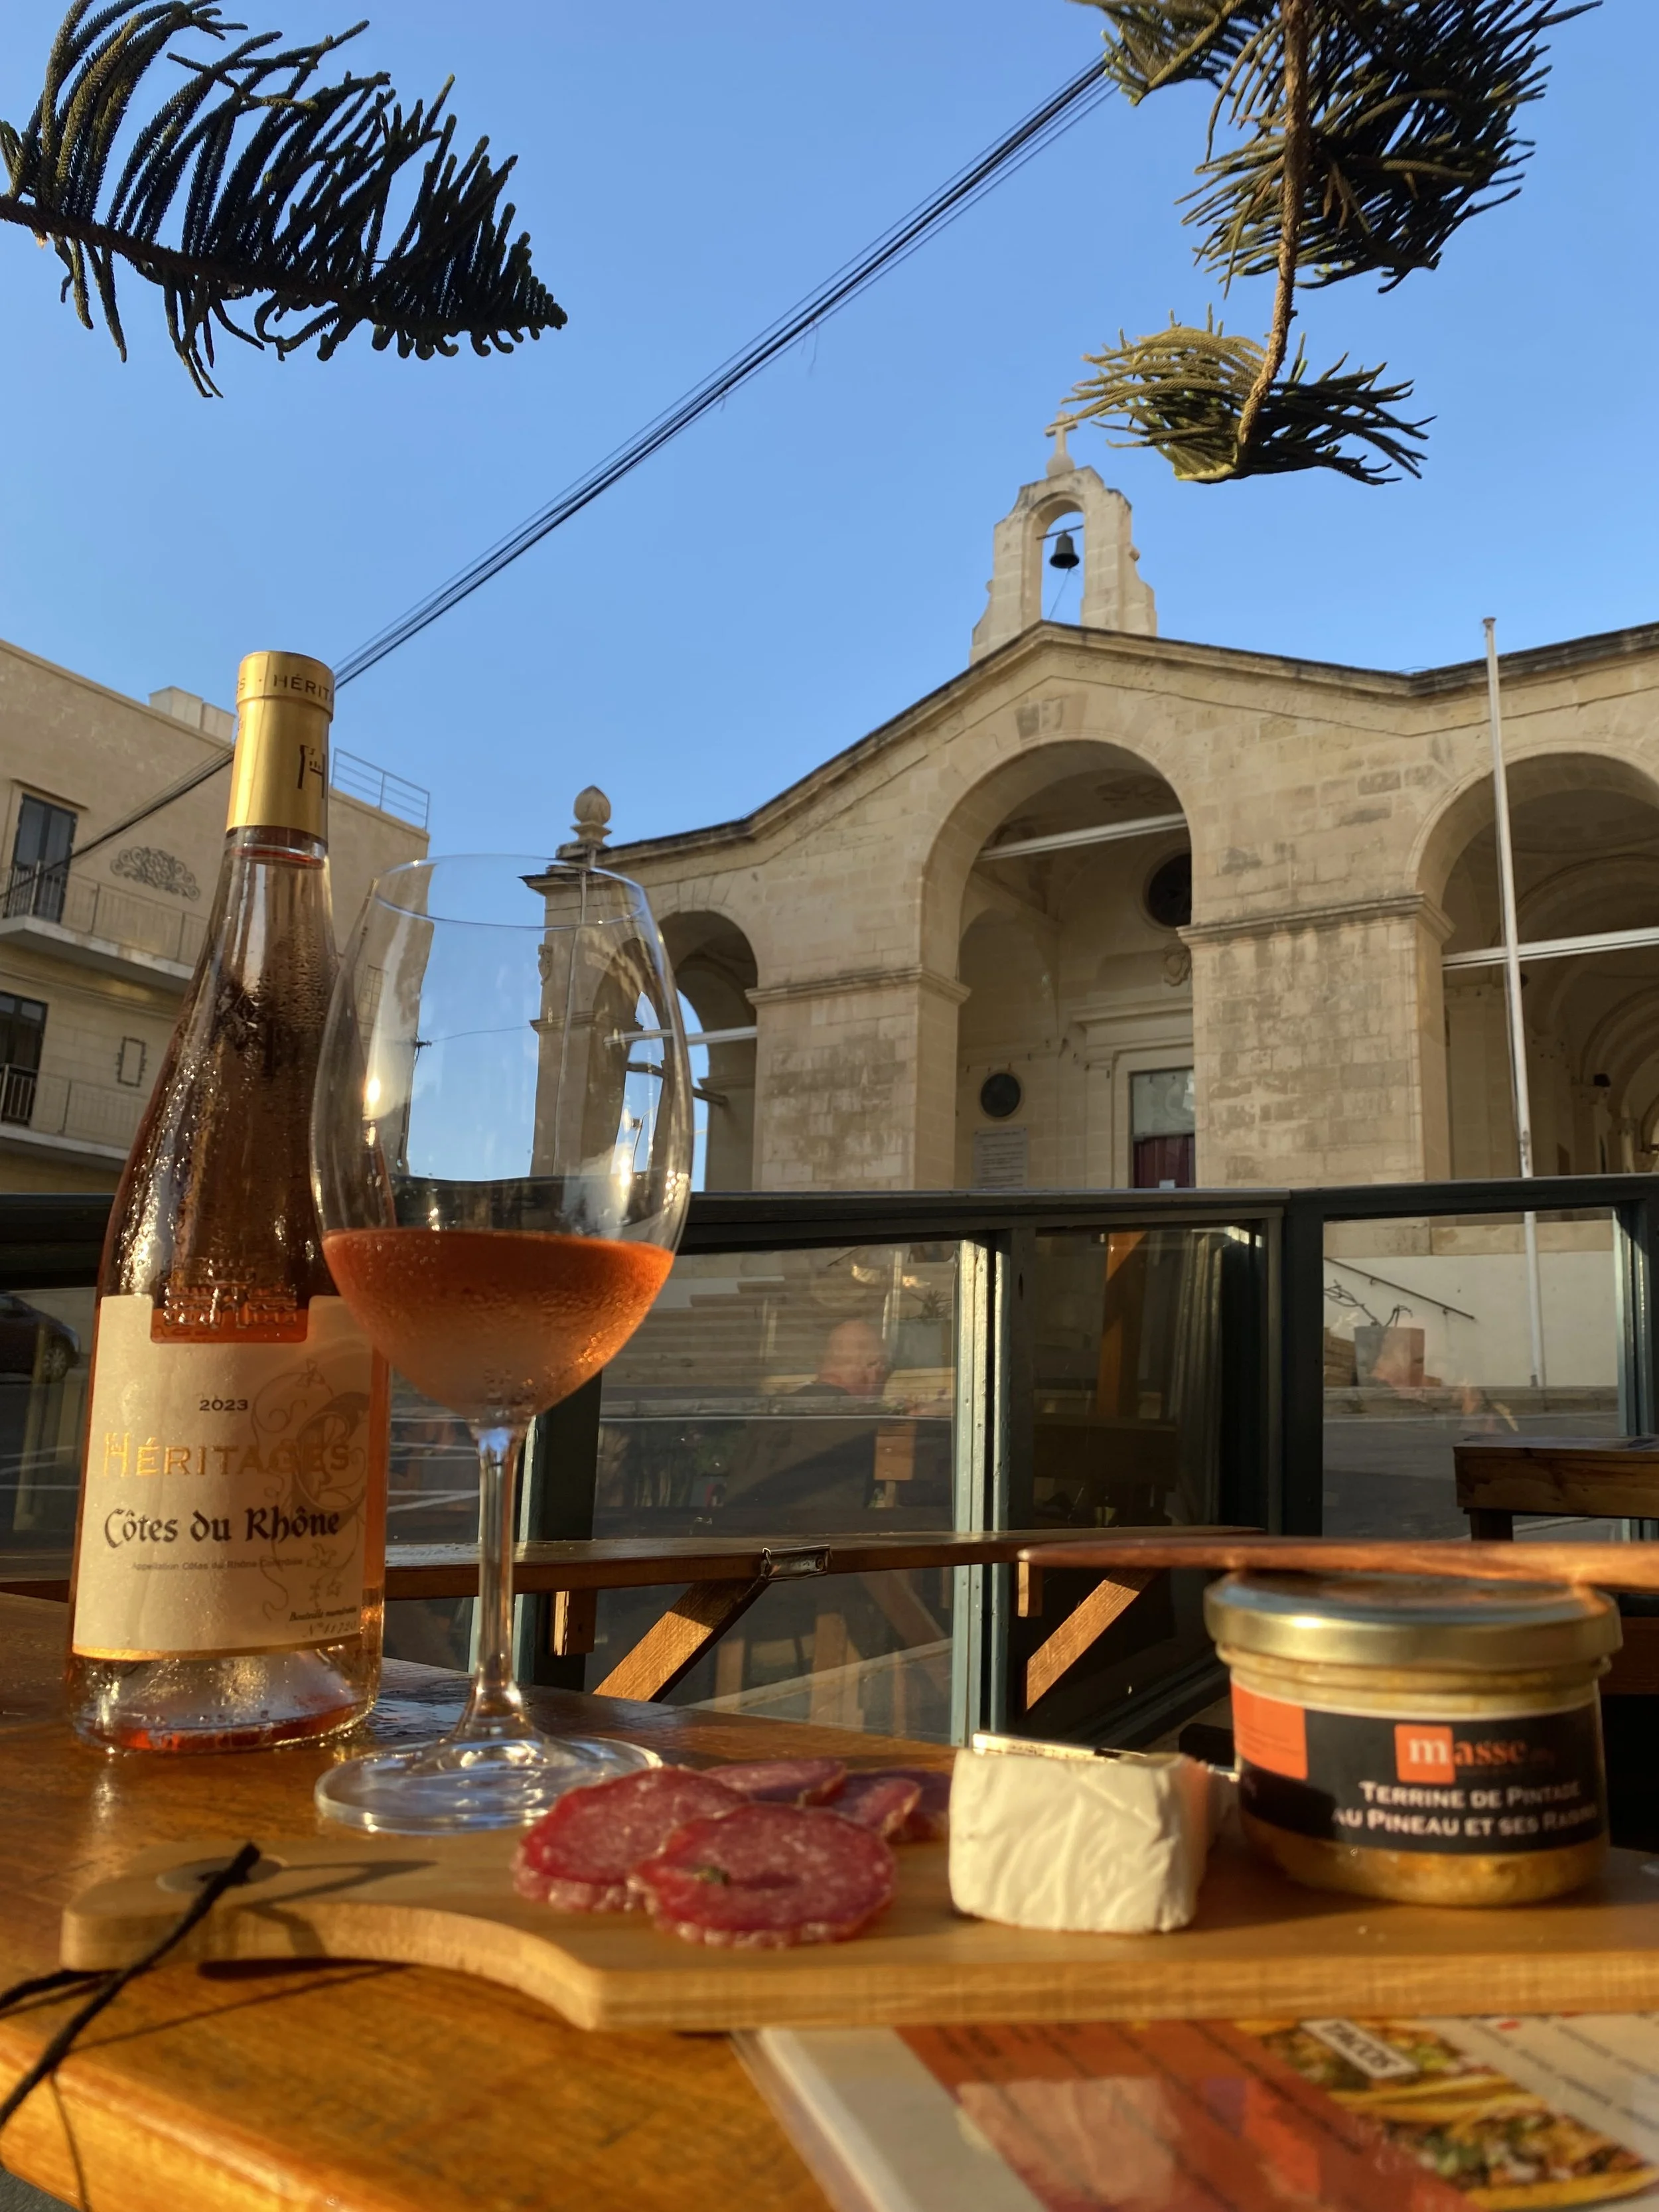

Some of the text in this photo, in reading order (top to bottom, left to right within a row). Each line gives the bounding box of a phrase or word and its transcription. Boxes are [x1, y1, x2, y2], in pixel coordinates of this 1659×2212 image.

[199, 1398, 249, 1412] 2023
[102, 1432, 352, 1477] HÉRITAGES
[104, 1505, 340, 1549] Côtes du Rhône
[1358, 1781, 1465, 1809] TERRINE
[1469, 1789, 1503, 1809] DE
[1332, 1807, 1364, 1828] AU
[1367, 1808, 1460, 1837] PINEAU
[1463, 1816, 1494, 1837] ET
